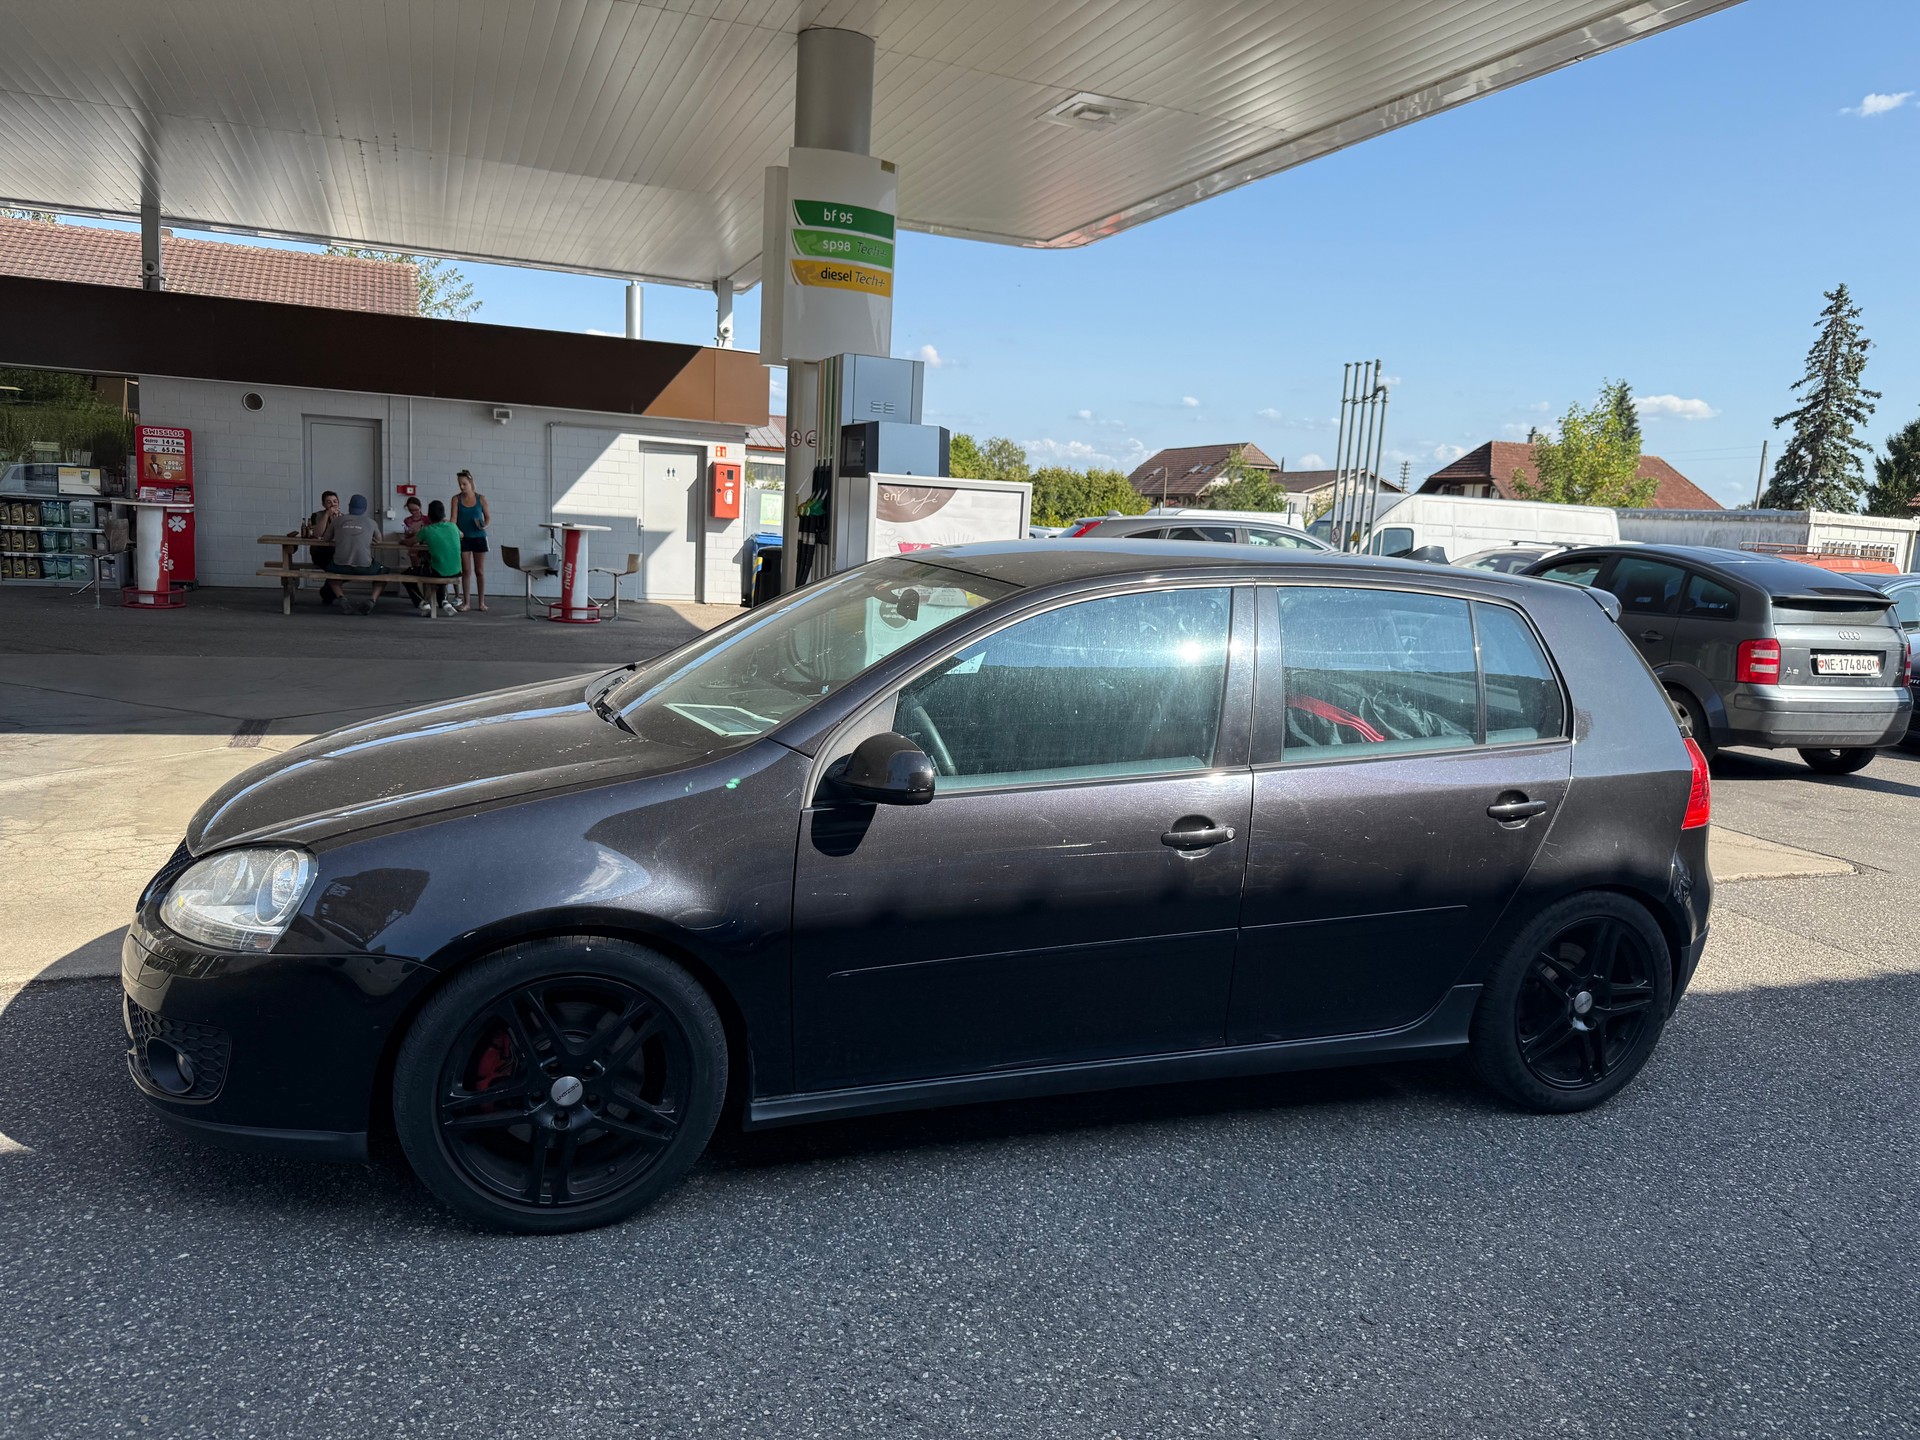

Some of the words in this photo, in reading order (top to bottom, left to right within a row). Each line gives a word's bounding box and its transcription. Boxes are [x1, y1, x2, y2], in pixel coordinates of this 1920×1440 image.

[823, 208, 837, 222] bf
[839, 212, 853, 224] 95
[822, 239, 851, 252] sp98
[856, 241, 887, 257] Tech+
[820, 268, 852, 282] diesel
[855, 271, 885, 287] Tech+
[143, 428, 185, 437] SWISSLOS
[883, 490, 900, 501] eni
